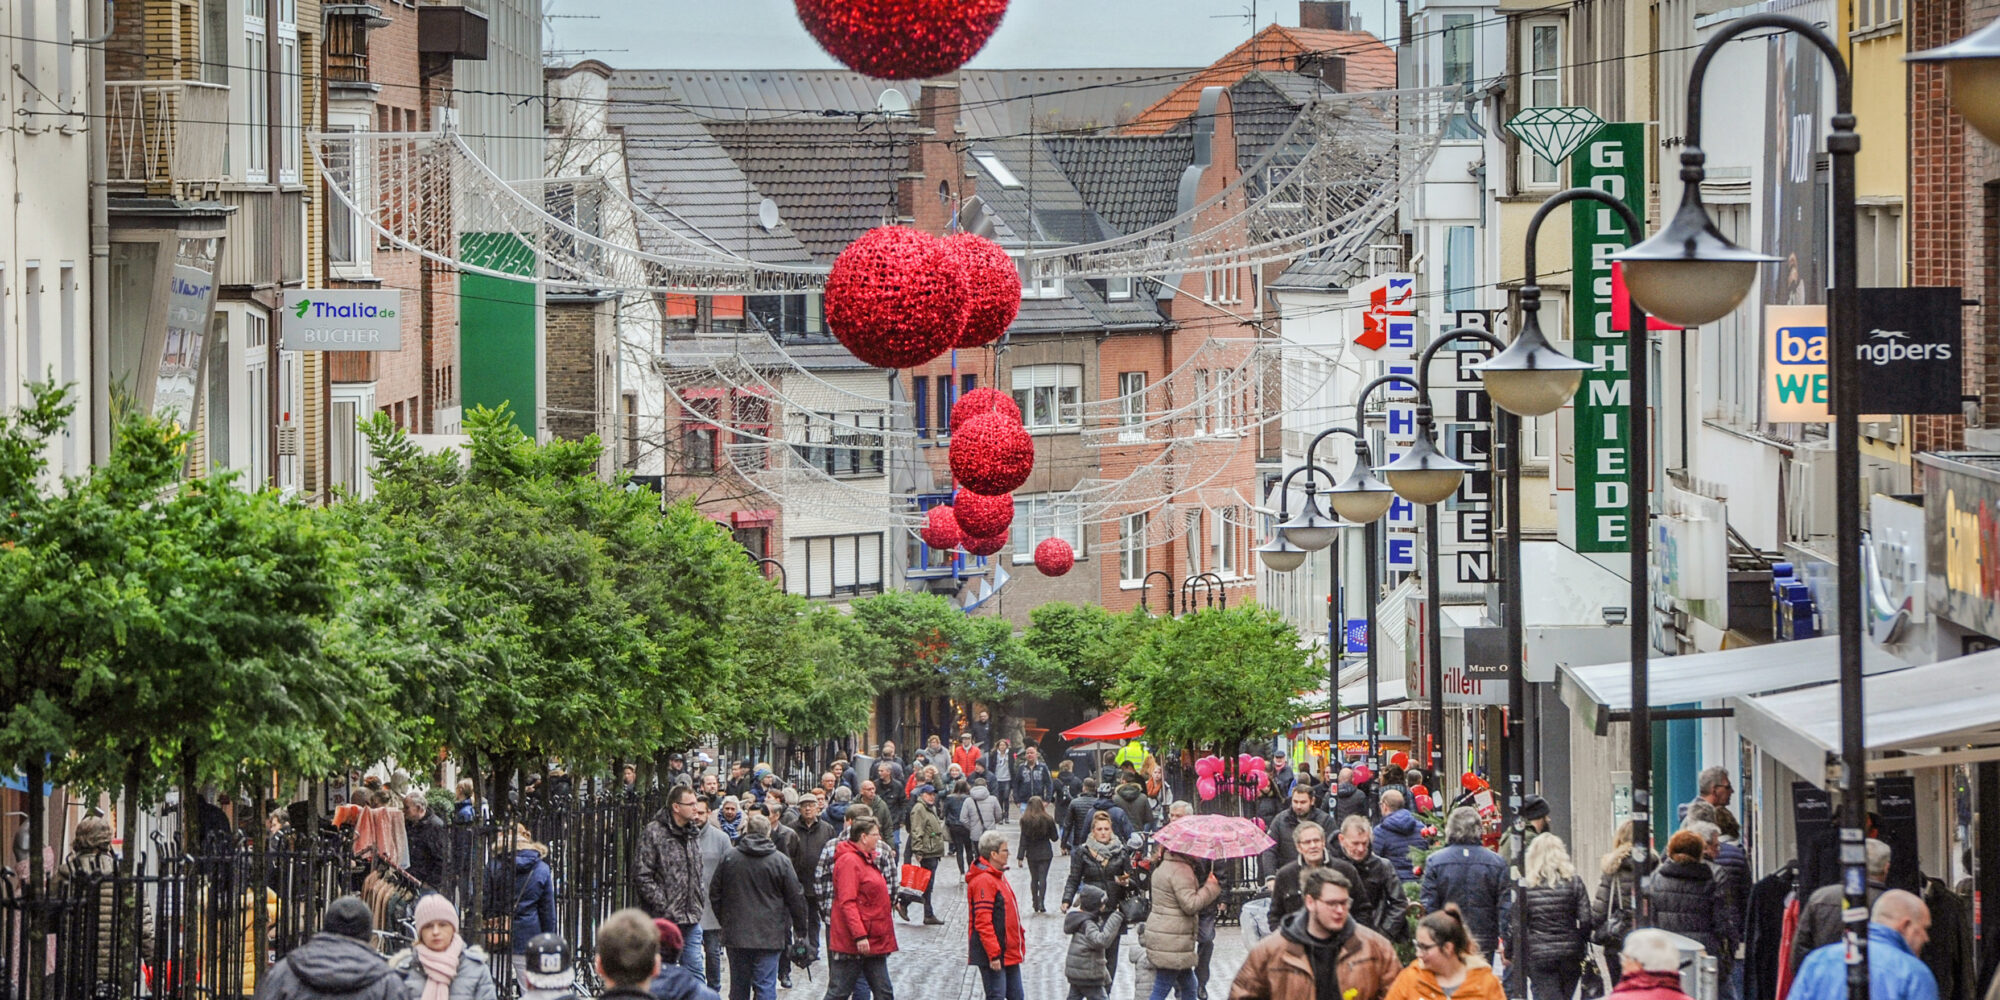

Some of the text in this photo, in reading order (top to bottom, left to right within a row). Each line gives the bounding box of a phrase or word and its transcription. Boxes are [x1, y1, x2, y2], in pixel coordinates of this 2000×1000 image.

[1780, 329, 1828, 362] ba
[1856, 338, 1952, 366] ngbers
[1389, 323, 1413, 564] SCHHE
[1461, 312, 1488, 581] BRILLEN
[1443, 667, 1482, 695] rillen
[1468, 664, 1509, 672] Marc O
